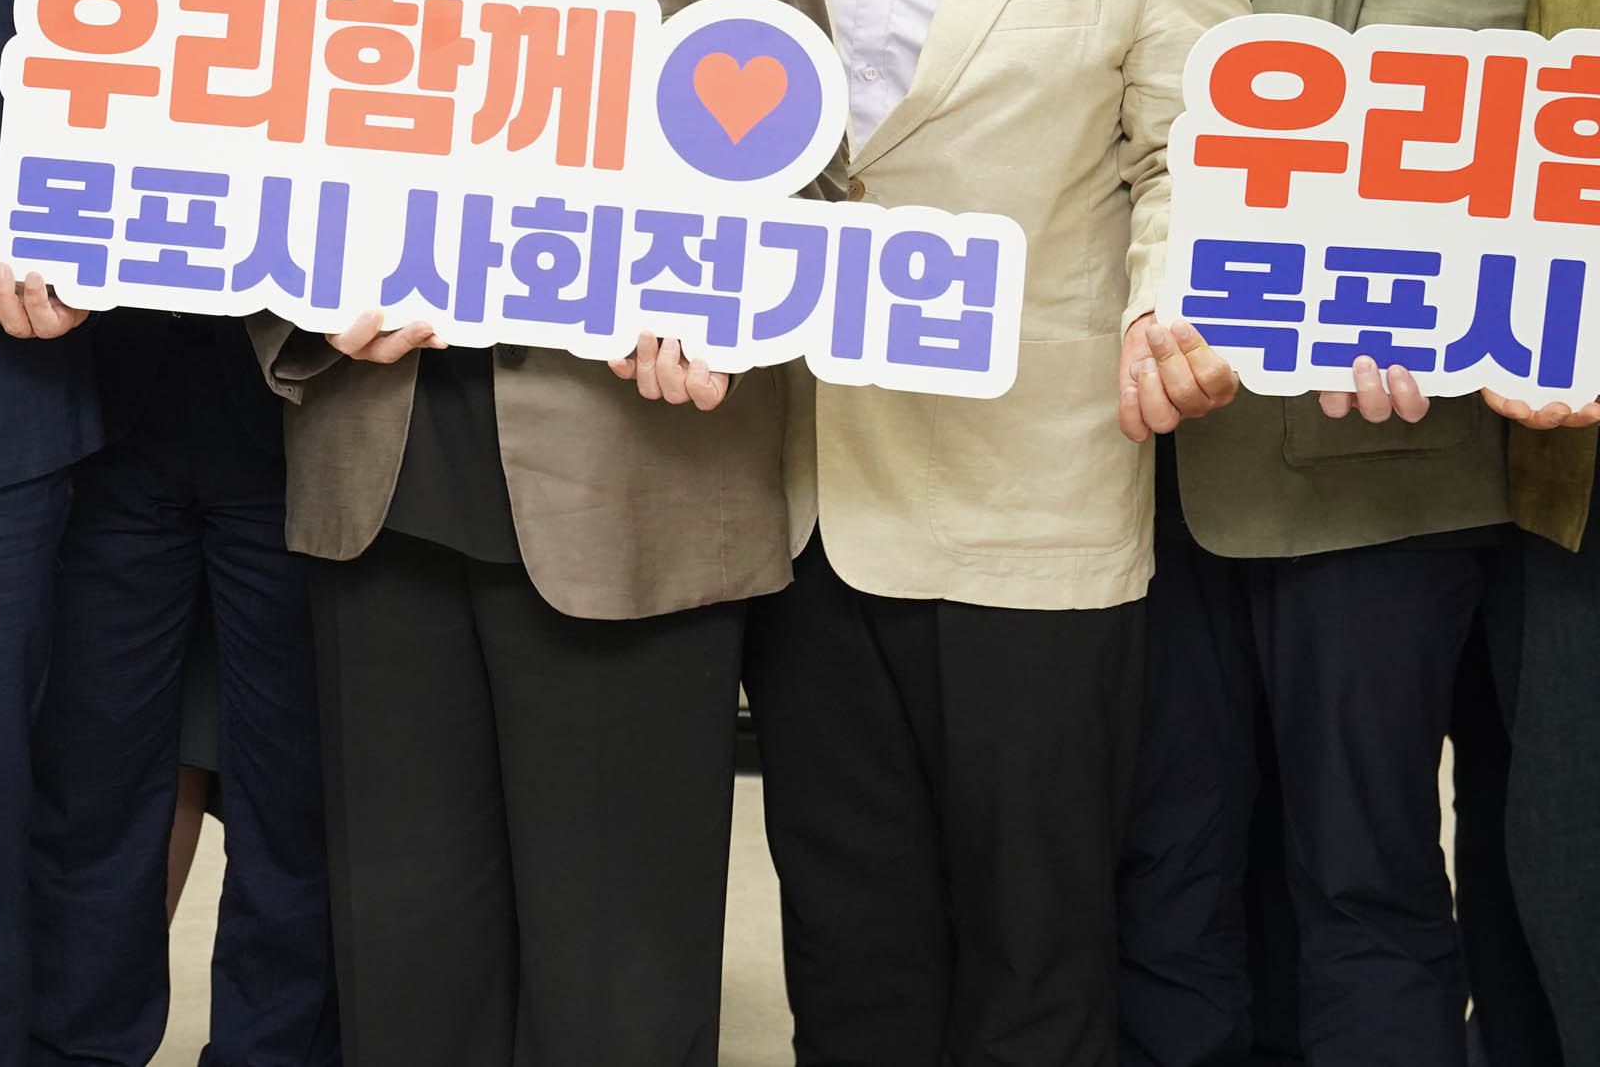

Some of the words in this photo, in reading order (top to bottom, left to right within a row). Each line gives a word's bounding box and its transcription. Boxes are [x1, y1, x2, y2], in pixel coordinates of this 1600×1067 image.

[10, 156, 350, 309] 목포시
[381, 188, 1000, 372] 사회적기업
[1182, 239, 1587, 389] 목포시
